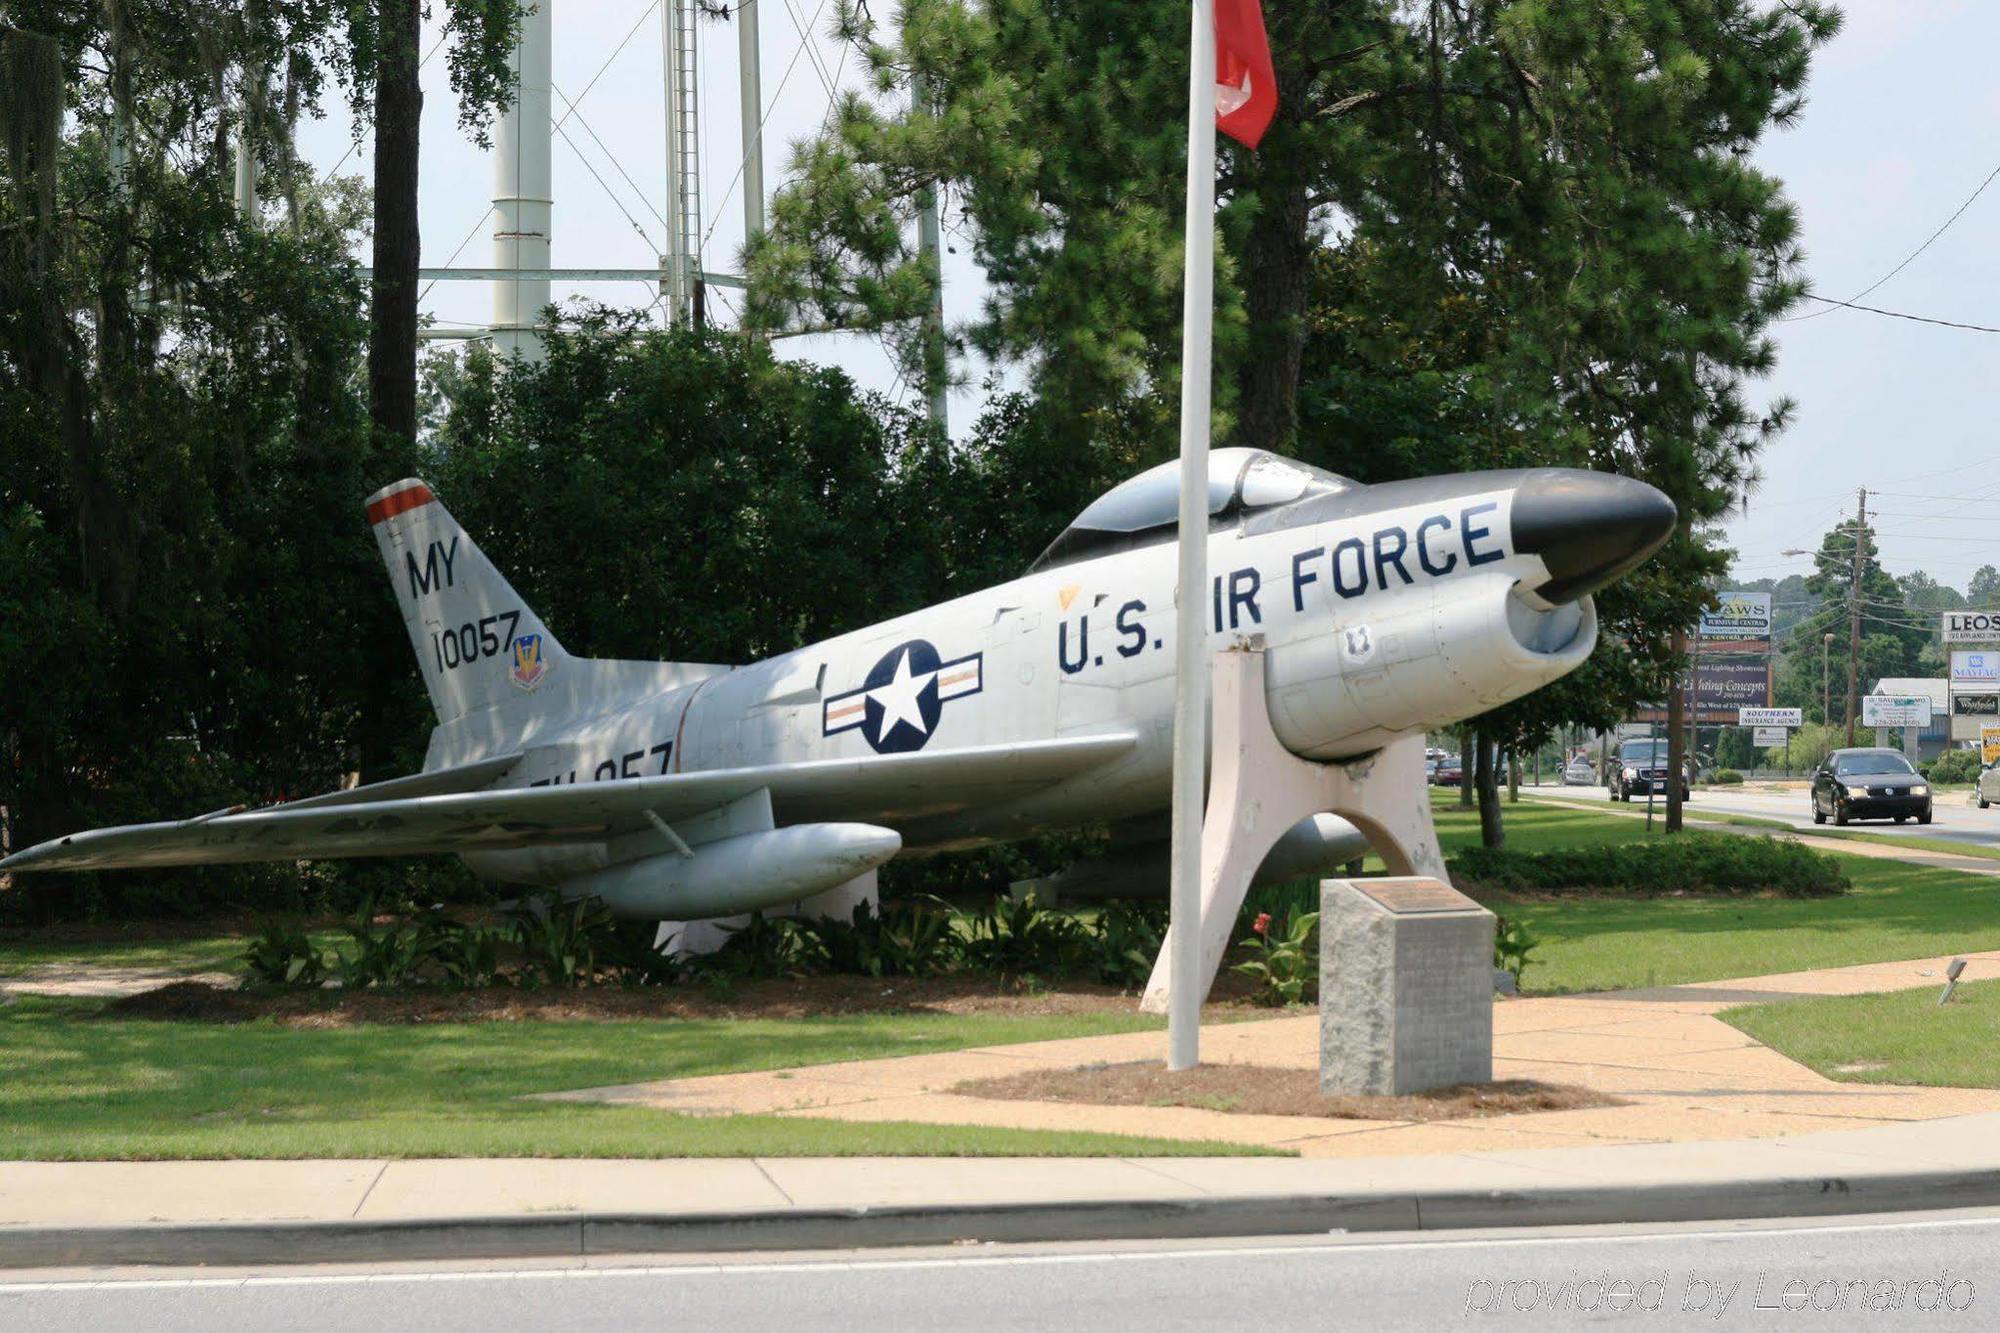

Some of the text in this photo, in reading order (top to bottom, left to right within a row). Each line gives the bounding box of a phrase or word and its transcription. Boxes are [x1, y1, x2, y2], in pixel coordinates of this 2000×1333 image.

[406, 536, 459, 599] MY
[1058, 502, 1505, 675] U.S. IR FORCE
[1723, 605, 1766, 615] AWS
[1740, 619, 1766, 627] CENTRAL
[433, 609, 521, 673] 10057
[1711, 664, 1735, 673] Lighting
[1735, 664, 1766, 672] Showroom
[1954, 669, 1998, 677] MAYTAG
[1684, 679, 1766, 697] Lihting Concepts
